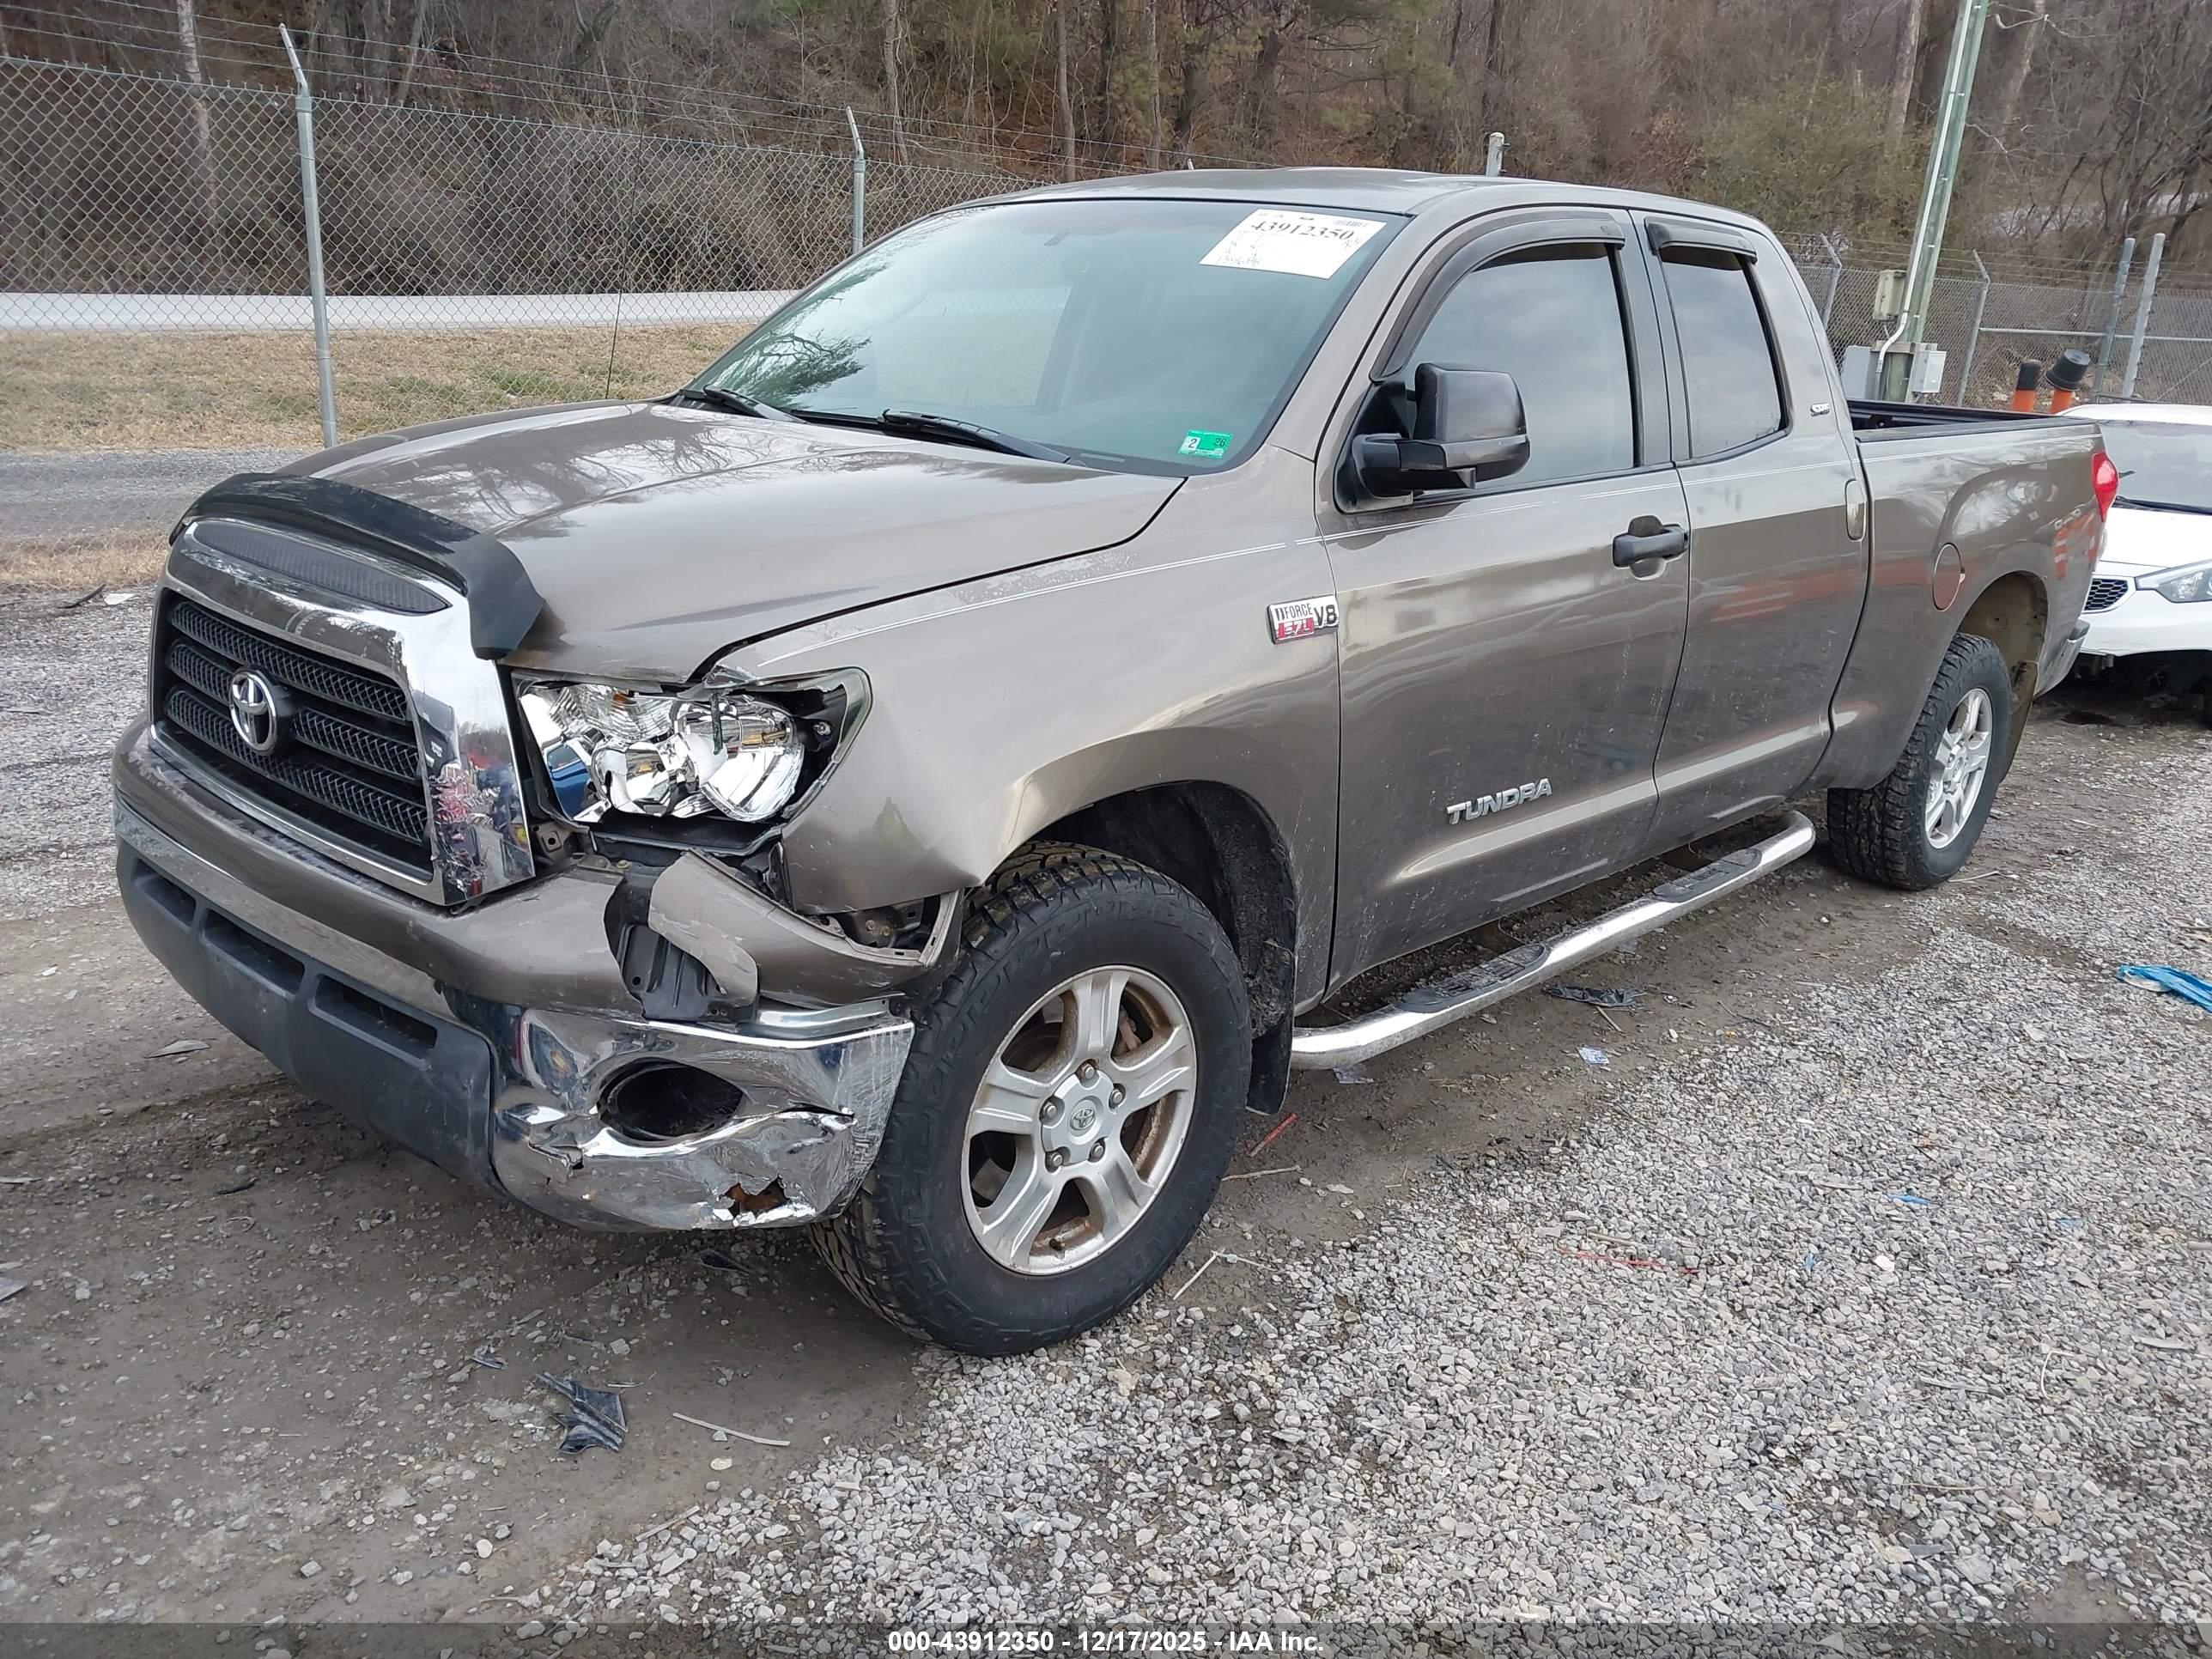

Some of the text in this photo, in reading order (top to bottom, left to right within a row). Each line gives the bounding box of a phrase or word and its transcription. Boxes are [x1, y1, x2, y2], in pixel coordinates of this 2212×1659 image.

[1250, 220, 1355, 241] 43912350
[1188, 438, 1198, 449] 2
[1314, 604, 1338, 627] V8
[1446, 777, 1553, 825] TUNDRA
